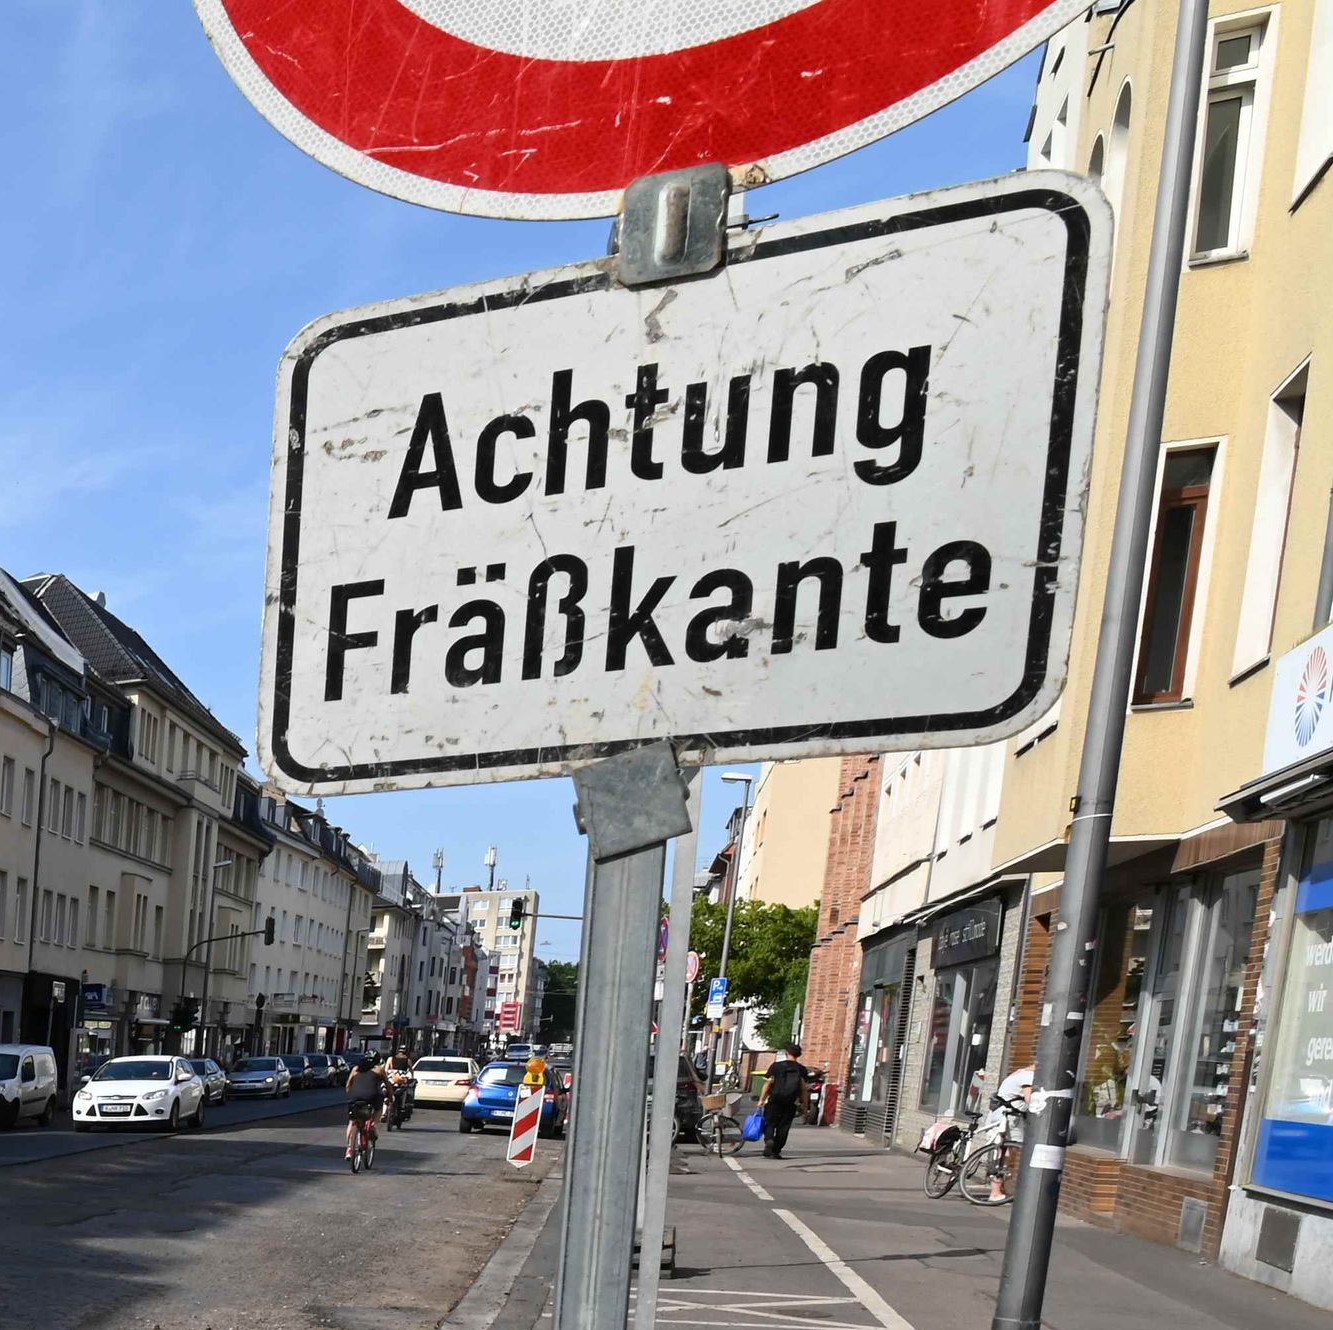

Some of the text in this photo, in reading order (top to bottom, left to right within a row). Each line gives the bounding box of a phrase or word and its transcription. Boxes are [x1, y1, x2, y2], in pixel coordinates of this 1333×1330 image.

[388, 344, 933, 520] Achtung
[323, 520, 993, 702] Fräßkante
[1306, 934, 1333, 966] werd
[1307, 983, 1327, 1012] wir
[1305, 1037, 1333, 1067] gere
